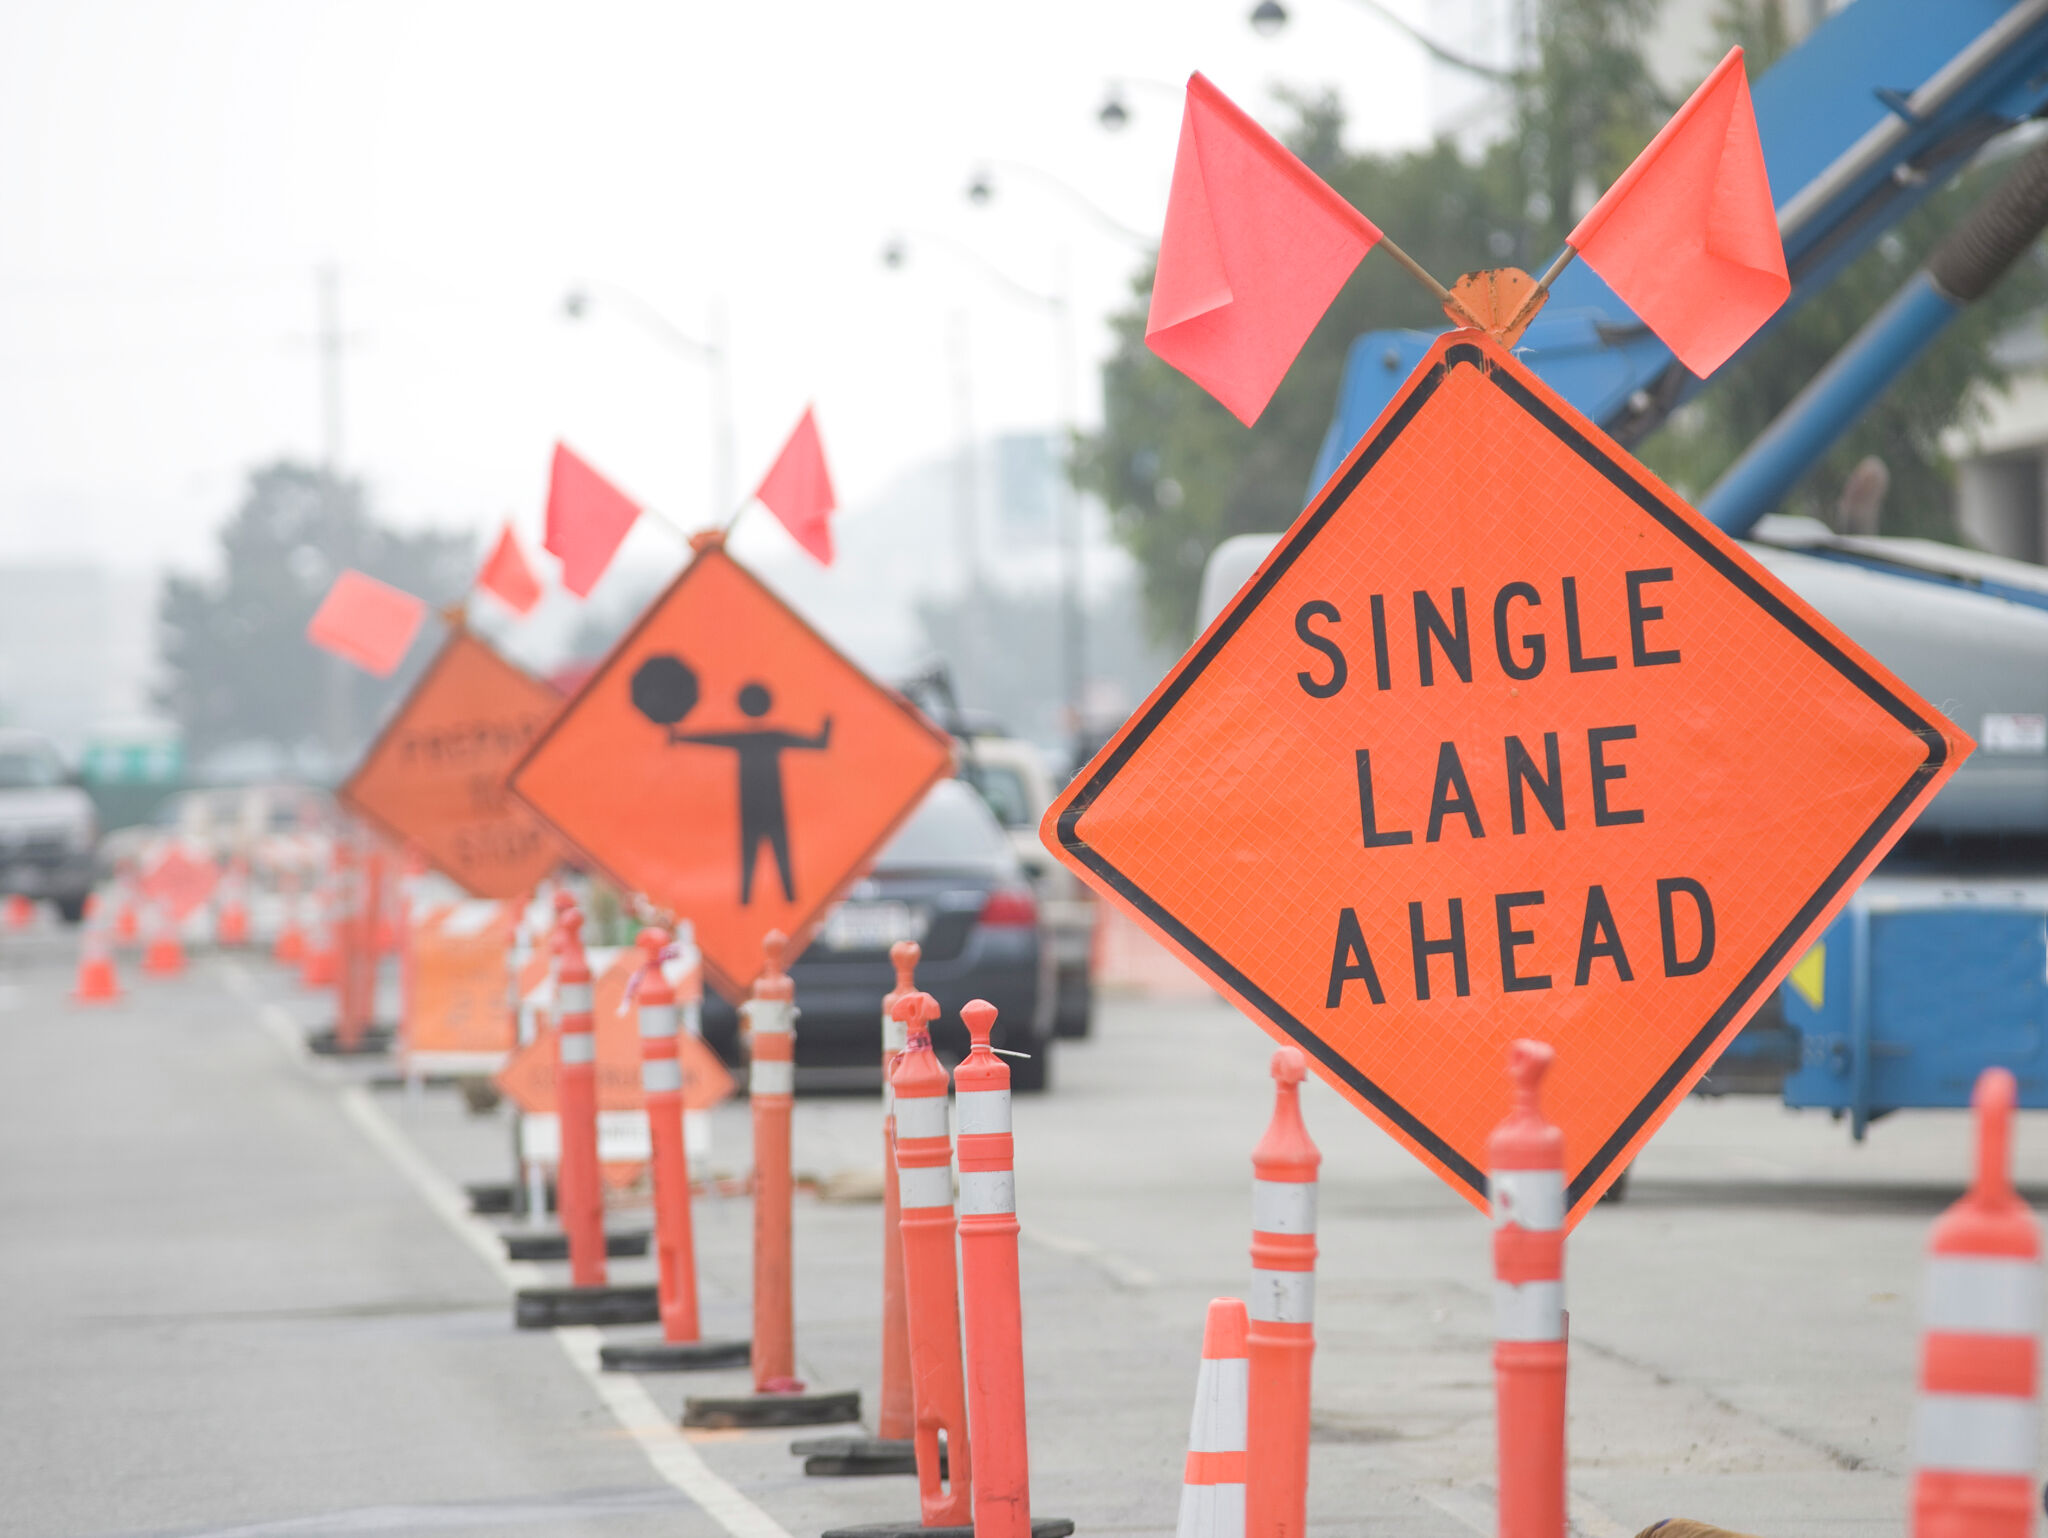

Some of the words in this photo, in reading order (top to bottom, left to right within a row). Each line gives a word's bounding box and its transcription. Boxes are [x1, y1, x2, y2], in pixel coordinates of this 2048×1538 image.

[1296, 567, 1681, 699] SINGLE
[1355, 724, 1645, 849] LANE
[1325, 876, 1716, 1009] AHEAD
